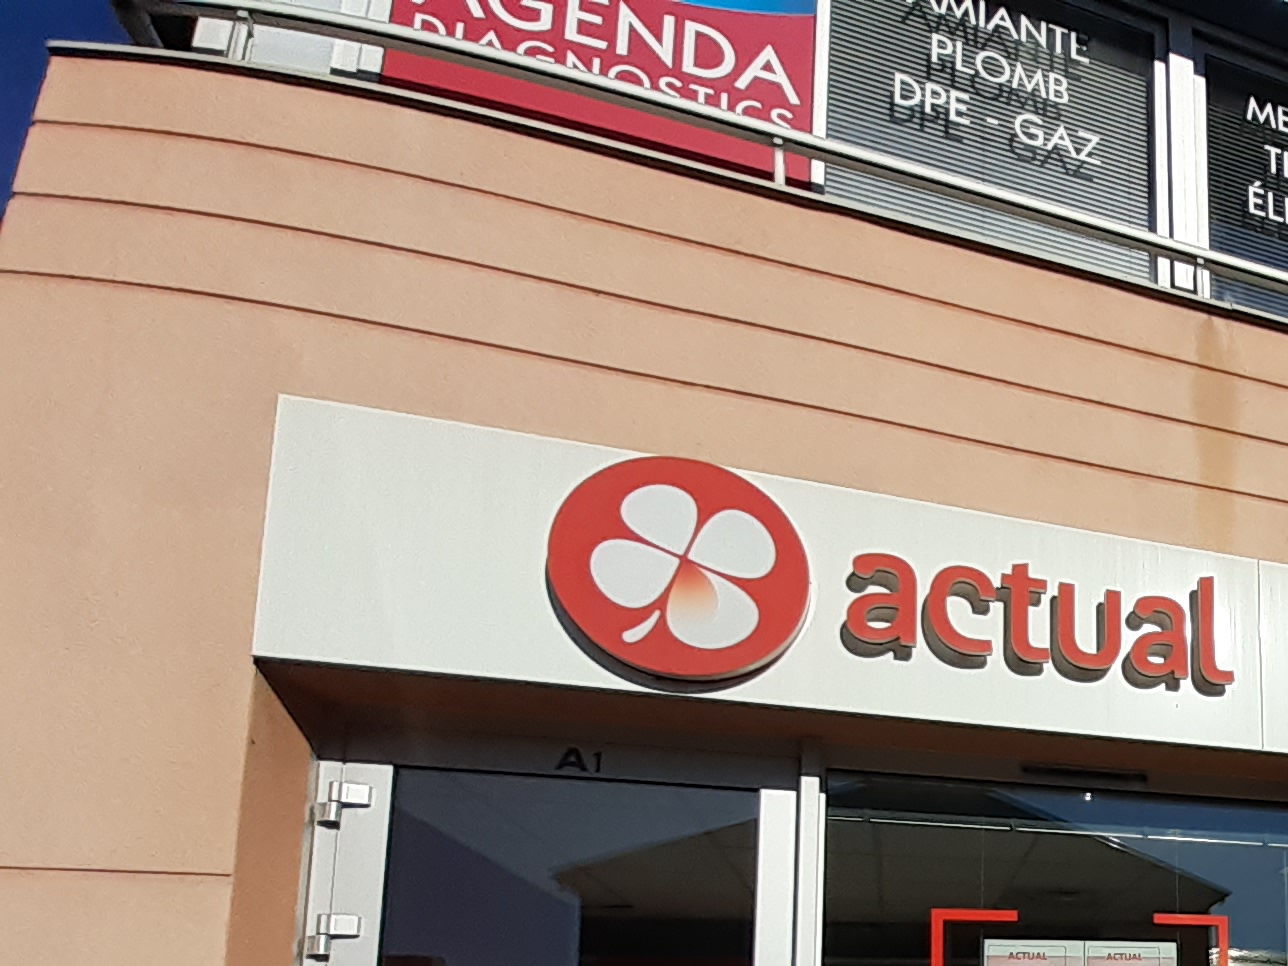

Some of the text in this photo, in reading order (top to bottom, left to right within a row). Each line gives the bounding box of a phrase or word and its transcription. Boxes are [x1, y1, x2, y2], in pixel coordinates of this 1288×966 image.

[421, 0, 801, 106] GENDA
[930, 32, 1070, 104] PLOMB
[893, 70, 971, 125] DPE
[1014, 113, 1102, 165] GAZ
[843, 551, 1236, 690] actual
[1007, 951, 1048, 961] ACTUAL
[1105, 952, 1143, 961] ACTUAL
